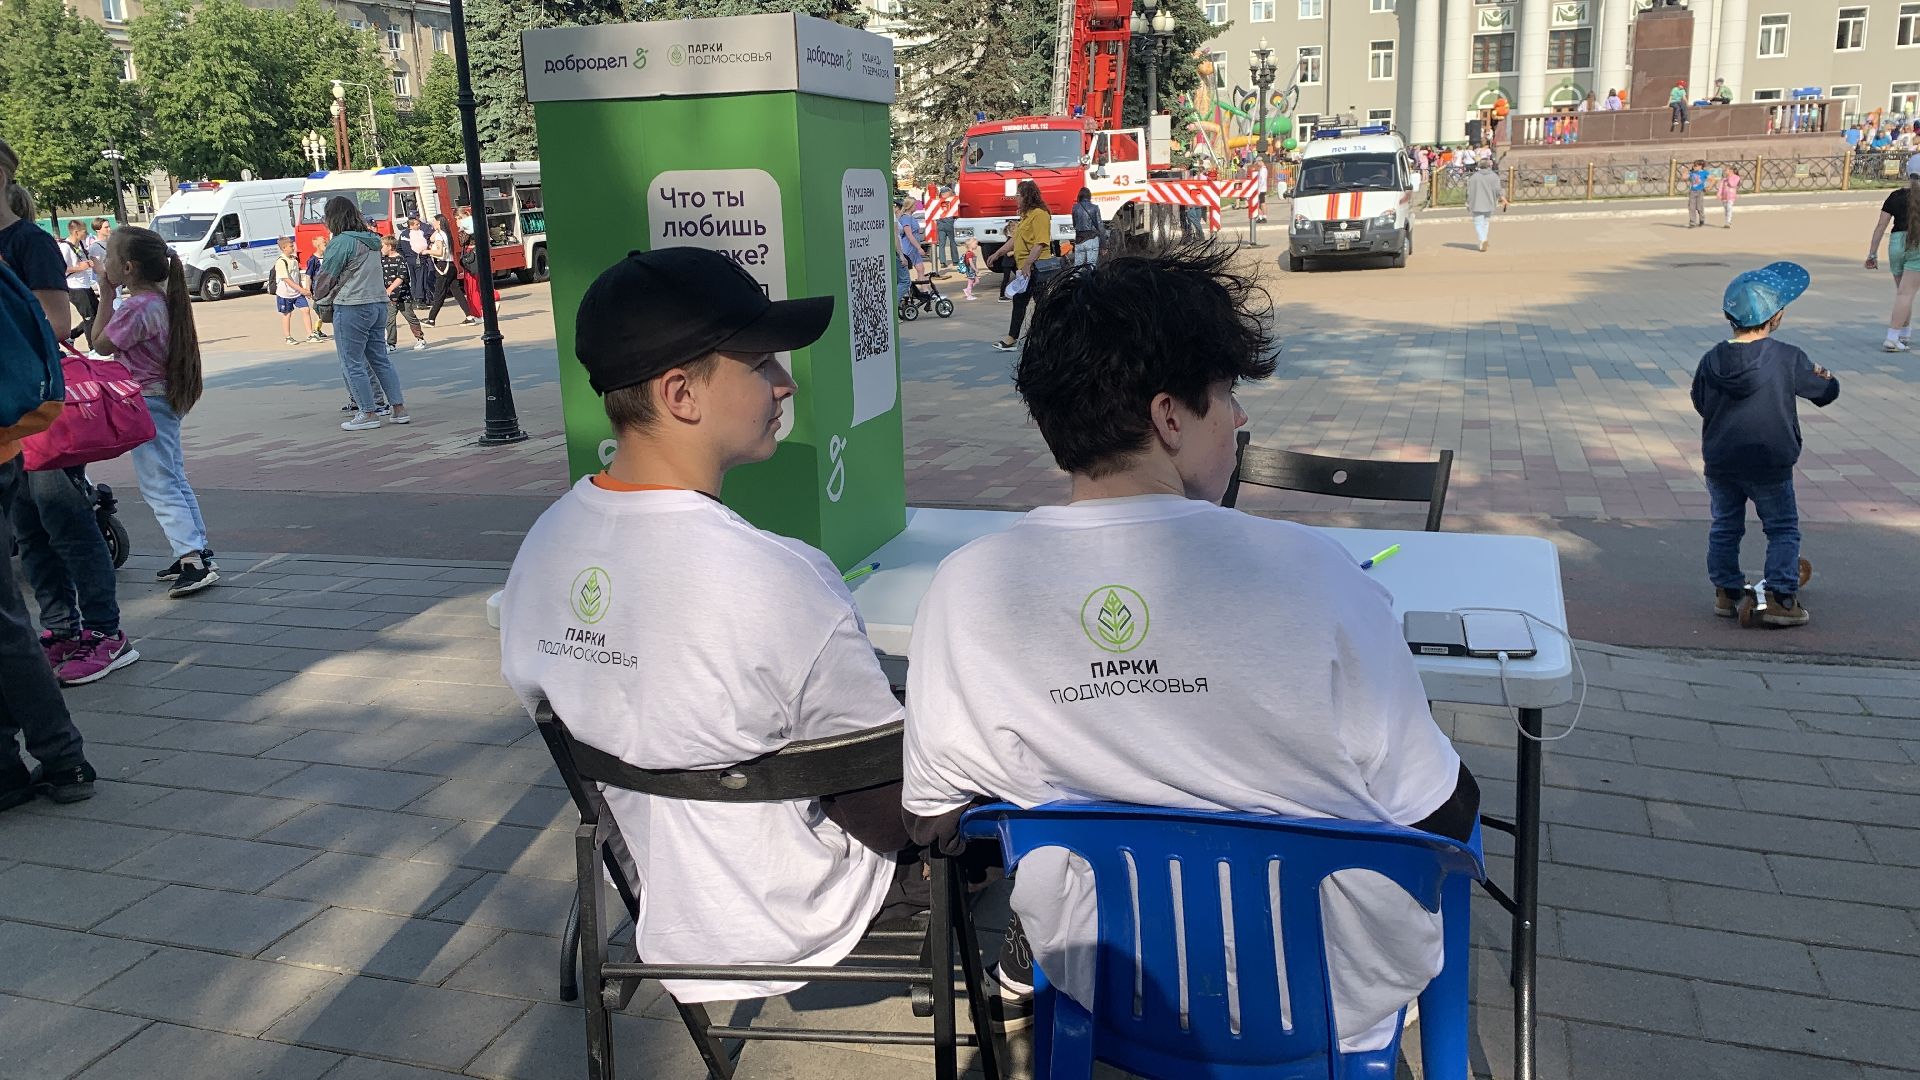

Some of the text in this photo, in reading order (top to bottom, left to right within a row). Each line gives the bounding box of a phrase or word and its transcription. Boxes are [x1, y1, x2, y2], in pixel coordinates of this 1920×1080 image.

[687, 43, 723, 54] ПАРКИ
[687, 51, 772, 66] ПОДМОСКОВЬЯ
[544, 54, 628, 73] добродел
[1112, 174, 1130, 186] 43
[660, 187, 745, 208] Что ты
[662, 213, 767, 237] любишь
[565, 627, 606, 647] ПАРКИ
[537, 639, 638, 669] ПОДМОСКОВЬЯ
[1090, 659, 1159, 679] ПАРКИ
[1049, 677, 1209, 704] ПОДМОСКОВЬЯ
